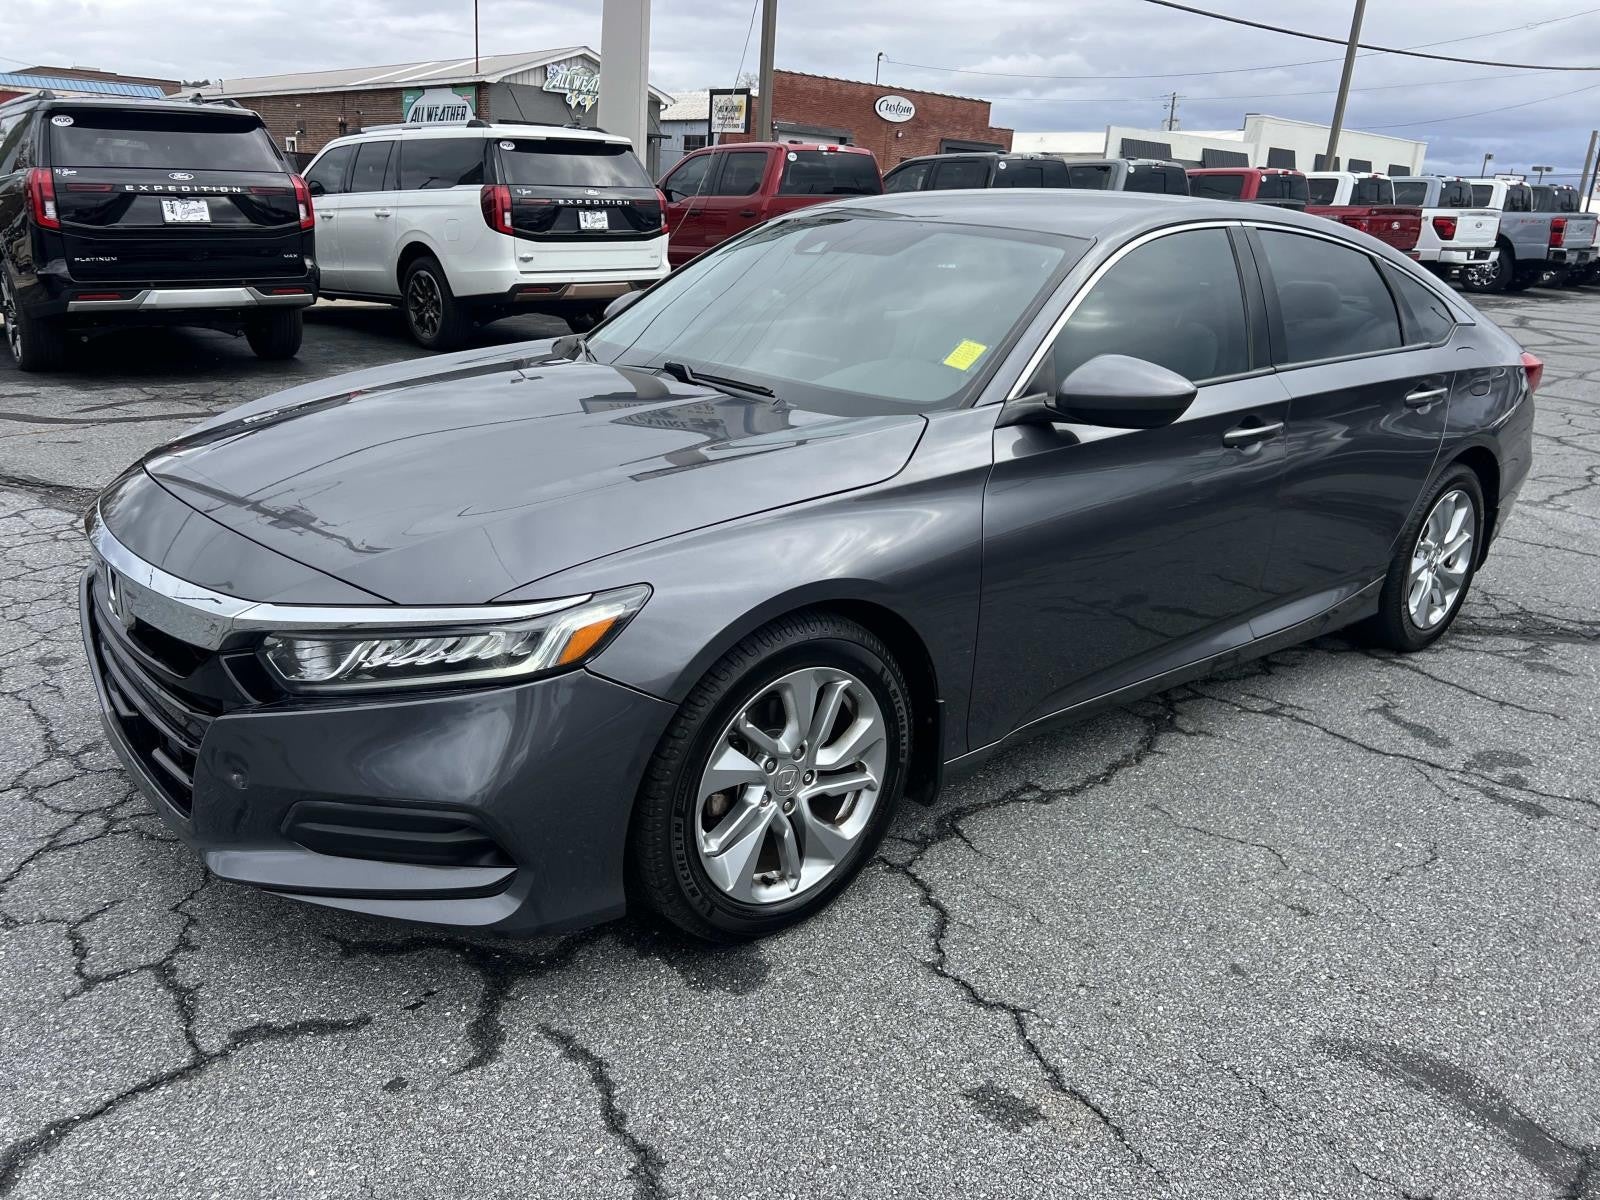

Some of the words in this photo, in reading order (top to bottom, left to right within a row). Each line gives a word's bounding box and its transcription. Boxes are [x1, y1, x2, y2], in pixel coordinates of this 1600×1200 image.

[549, 73, 571, 89] ALL
[409, 106, 425, 123] ALL
[427, 105, 467, 122] WEATHER
[878, 99, 913, 116] Custom
[125, 185, 241, 193] EXPEDITION
[890, 688, 906, 759] MICHELIN
[674, 822, 700, 898] MICHELIN
